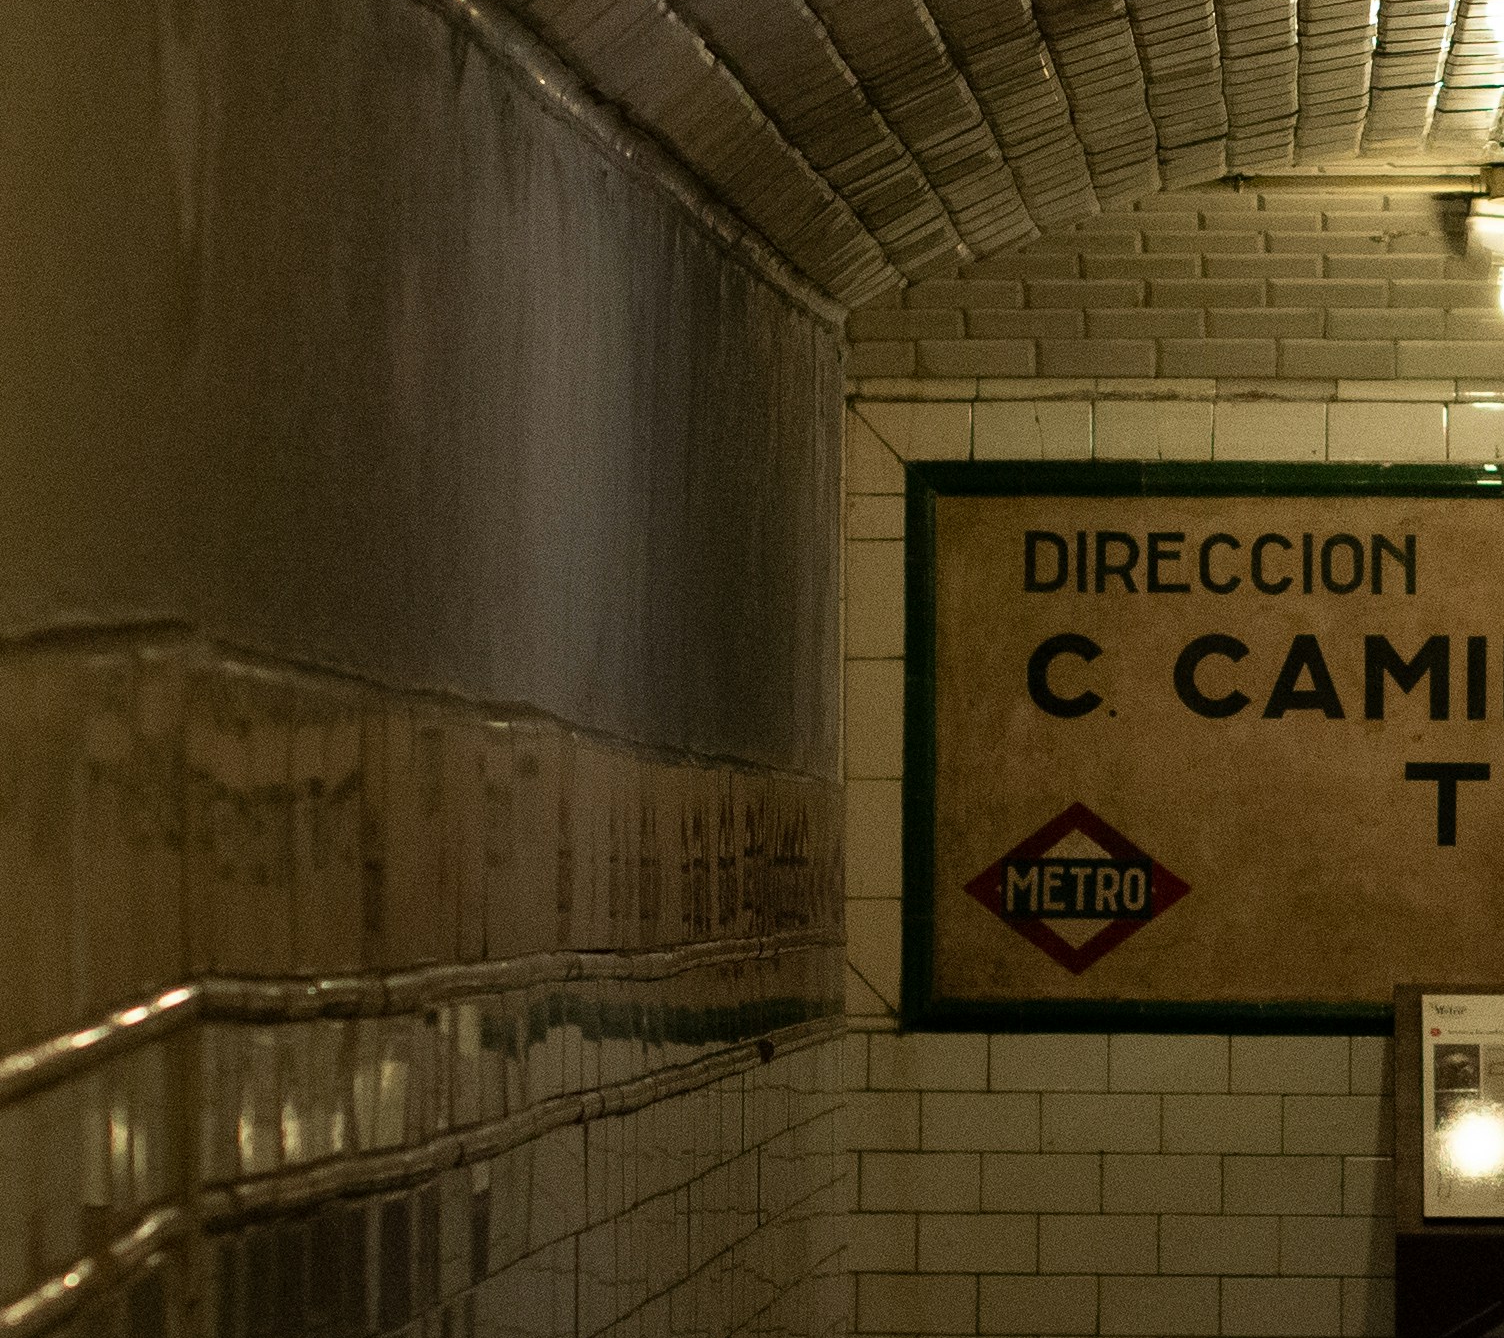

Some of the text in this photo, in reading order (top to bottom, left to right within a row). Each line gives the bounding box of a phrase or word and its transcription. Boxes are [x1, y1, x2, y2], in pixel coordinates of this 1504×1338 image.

[1024, 530, 1416, 596] DIRECCION
[1027, 633, 1117, 719] C.
[1004, 865, 1146, 912] METRO
